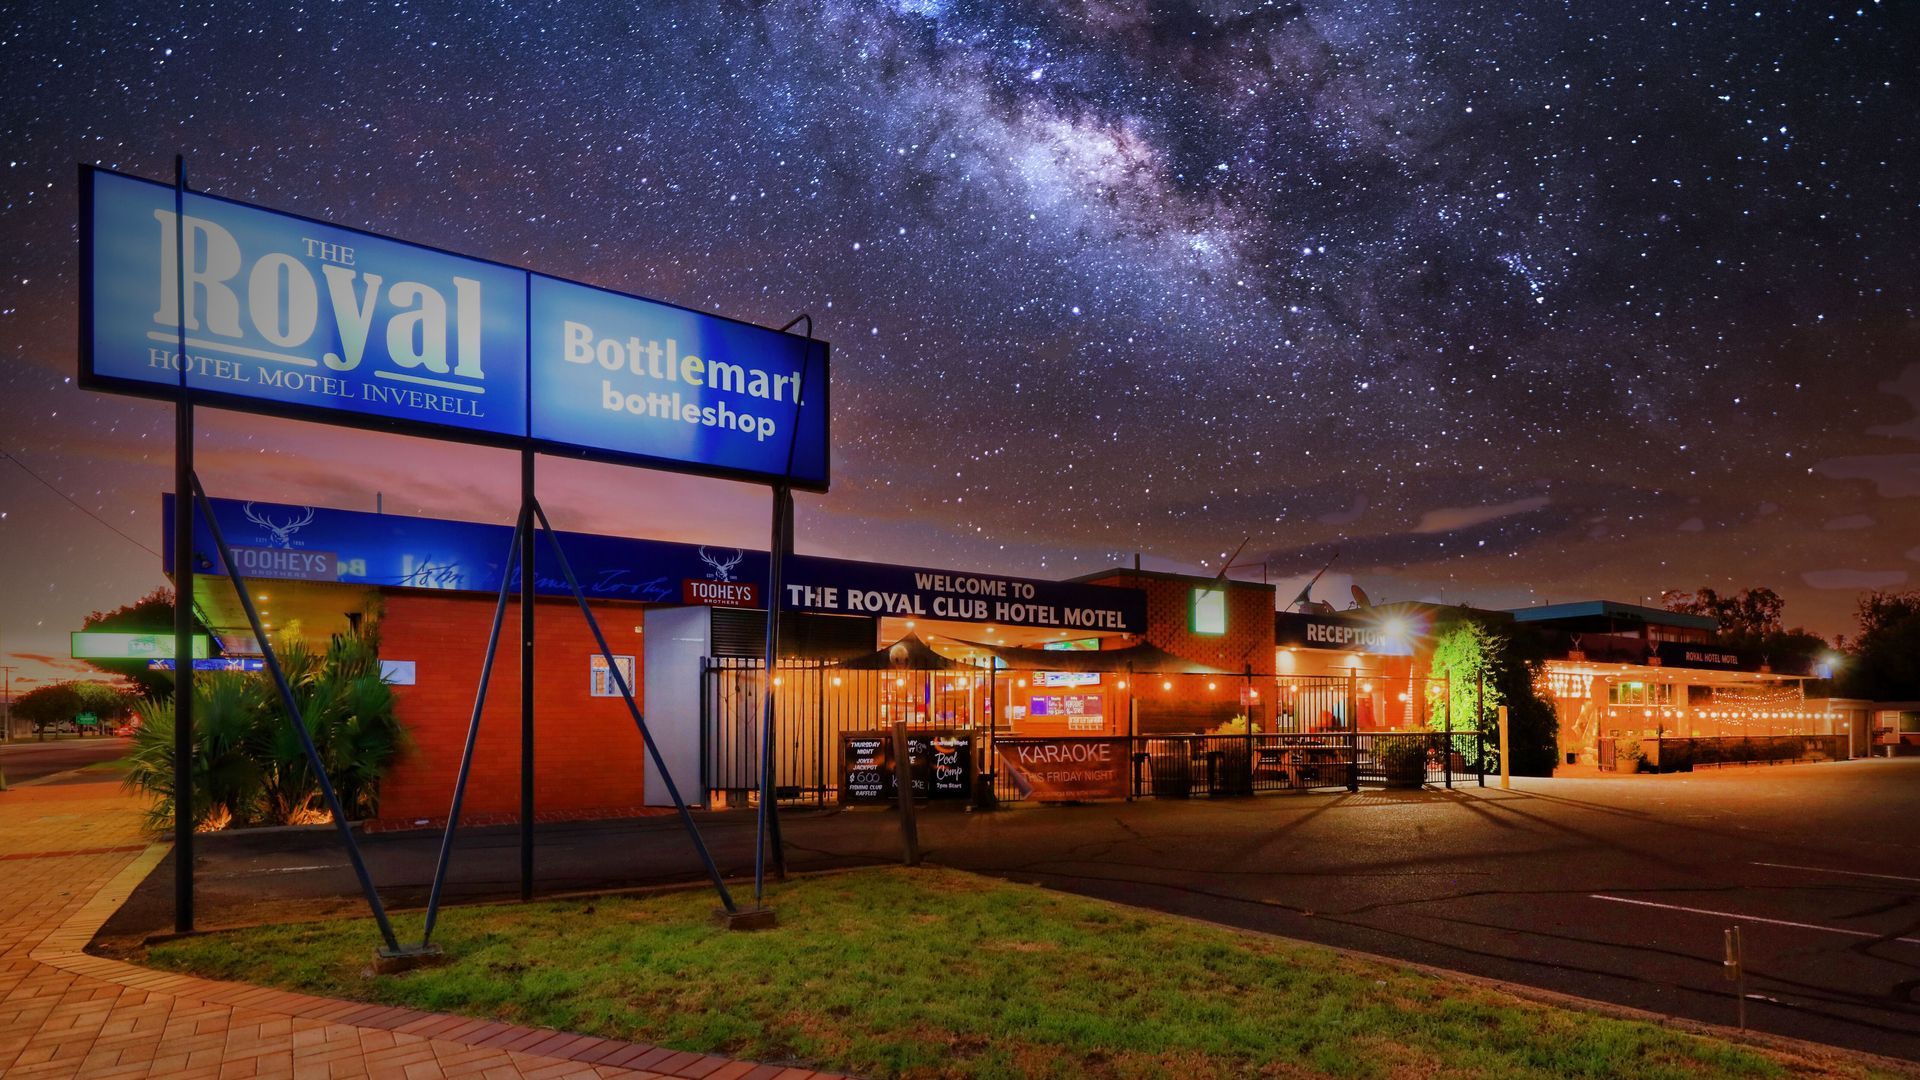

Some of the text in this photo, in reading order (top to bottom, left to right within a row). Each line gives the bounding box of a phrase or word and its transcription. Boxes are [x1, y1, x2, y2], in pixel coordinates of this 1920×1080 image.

[302, 237, 355, 266] THE
[153, 209, 485, 380] Royal
[564, 320, 805, 406] Bottlemart
[147, 348, 485, 418] HOTEL MOTEL INVERELL
[602, 380, 776, 442] bottleshop
[230, 549, 327, 573] TOOHEYS
[690, 582, 752, 601] TOOHEYS
[915, 572, 1035, 600] WELCOME TO
[703, 598, 739, 606] BROTHERS
[787, 584, 1126, 629] THE ROYAL CLUB HOTEL MOTEL
[1307, 623, 1386, 647] RECEPTION
[1685, 651, 1738, 664] ROYAL HOTEL MOTEL
[934, 752, 957, 766] Pool
[1018, 744, 1111, 764] KARAOKE
[936, 765, 962, 781] Comp
[1047, 771, 1084, 782] FRIDAY
[1085, 769, 1114, 781] NIGHT
